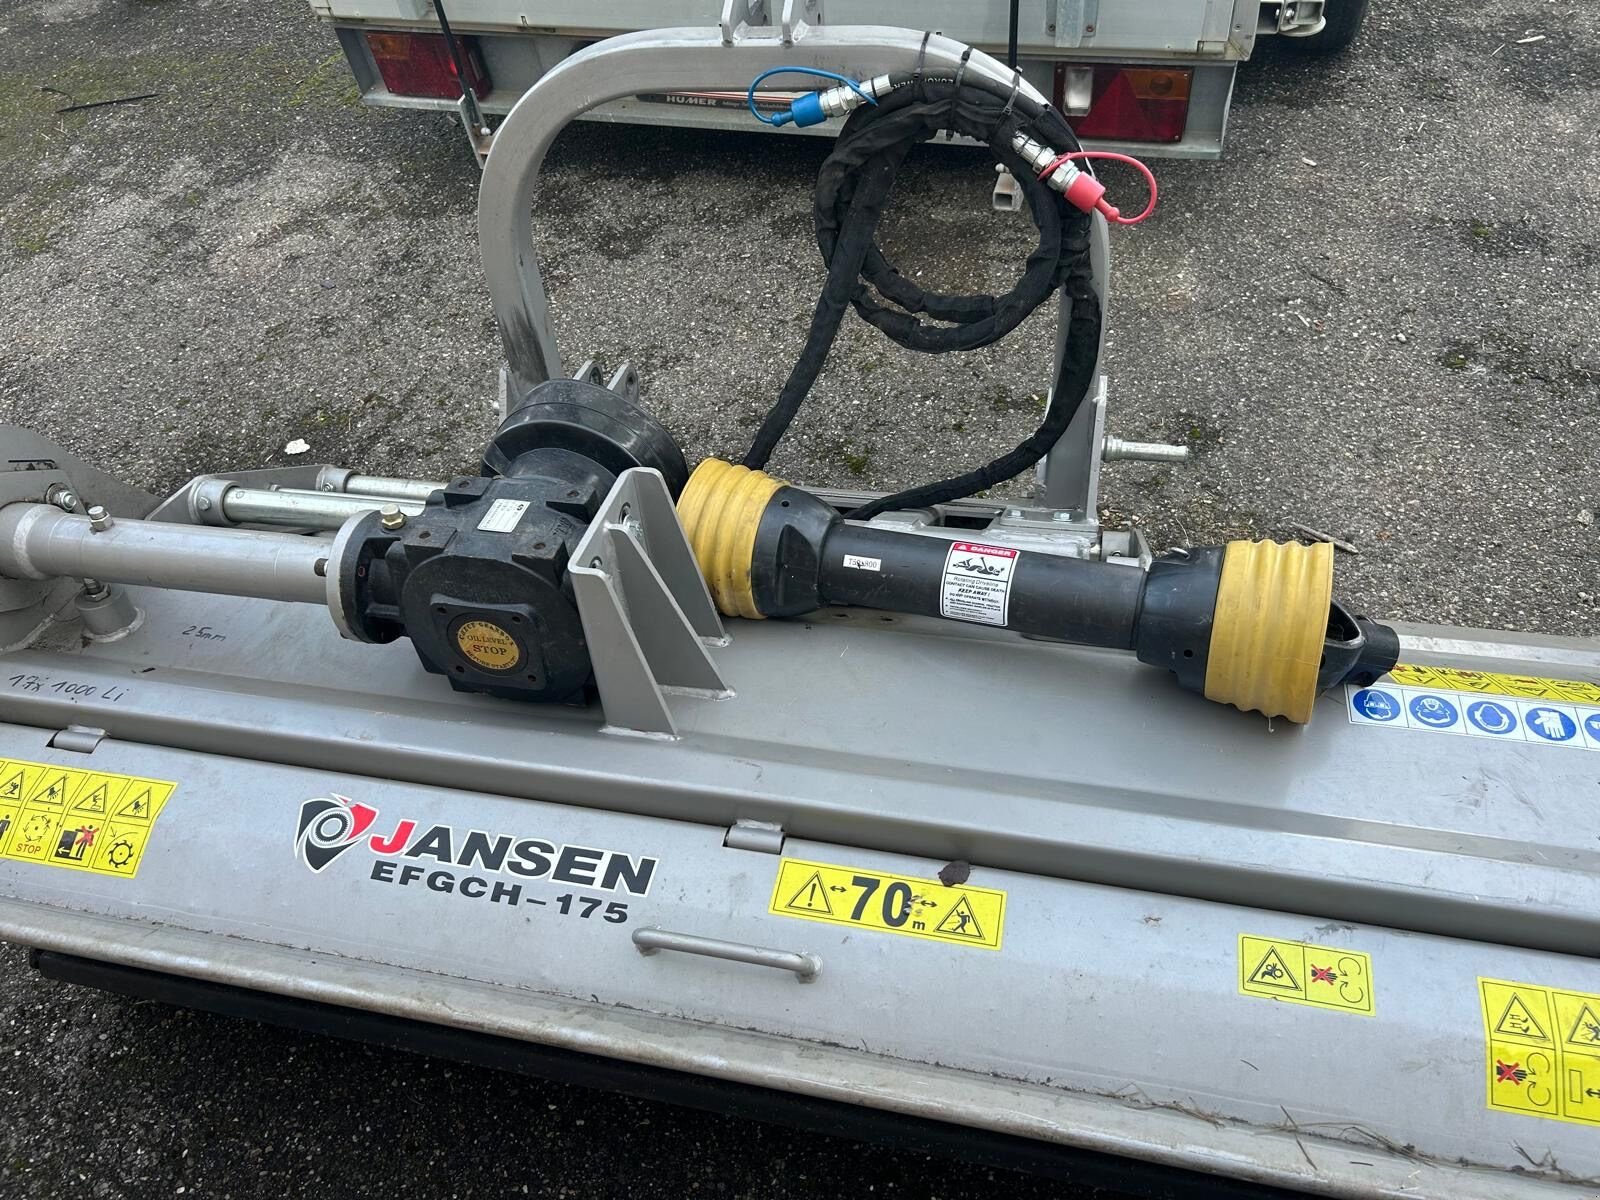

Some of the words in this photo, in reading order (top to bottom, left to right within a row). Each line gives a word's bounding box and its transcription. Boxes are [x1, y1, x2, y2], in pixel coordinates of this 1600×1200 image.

[666, 95, 717, 106] HUMER
[970, 544, 1012, 557] DANGER
[181, 625, 227, 642] 25mm
[482, 636, 508, 646] LEVEL
[472, 644, 508, 656] STOP
[51, 681, 97, 697] 1000
[16, 843, 42, 855] STOP
[368, 818, 657, 896] JANSEN
[369, 859, 629, 924] EFGCH-175
[849, 875, 913, 928] 70
[912, 921, 926, 931] m
